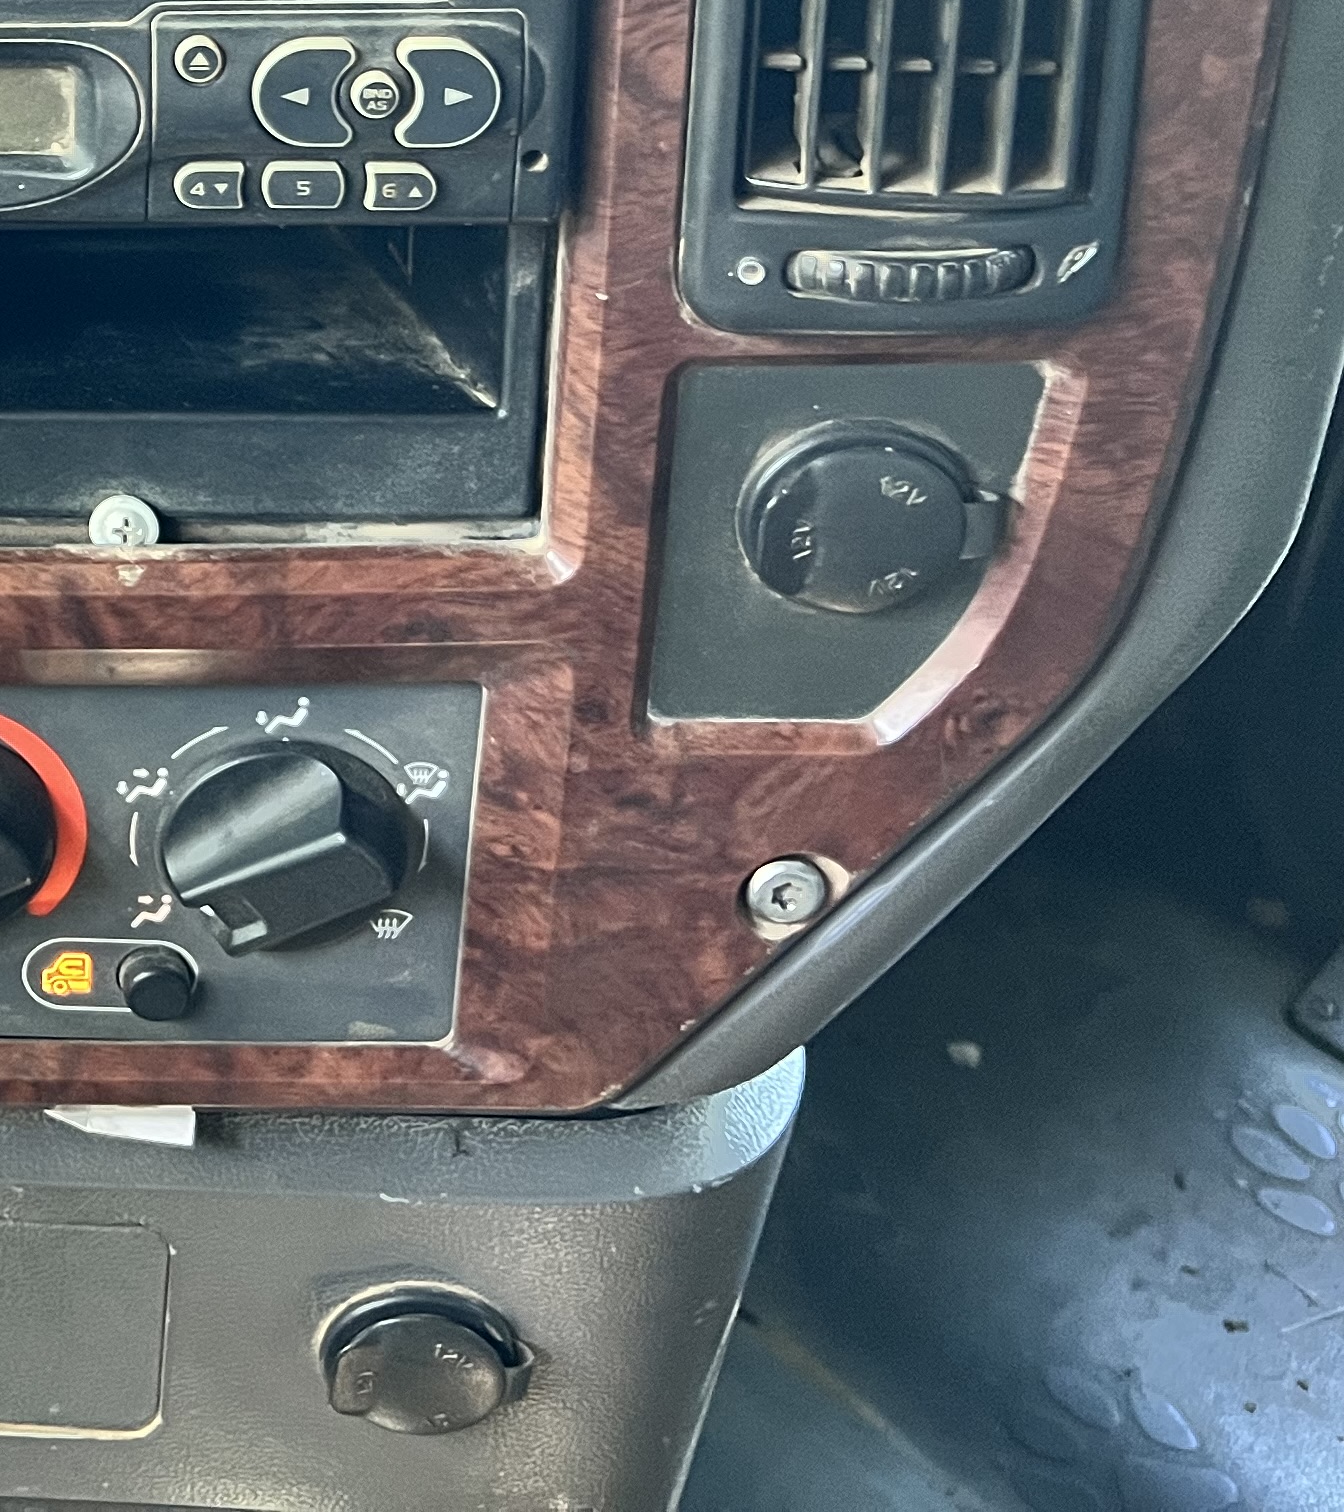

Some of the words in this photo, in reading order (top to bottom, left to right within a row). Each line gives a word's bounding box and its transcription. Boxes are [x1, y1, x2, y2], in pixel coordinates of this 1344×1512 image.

[362, 88, 391, 99] BND
[366, 100, 388, 111] AS
[189, 181, 206, 196] 4
[295, 180, 311, 196] 5
[381, 183, 397, 198] 6
